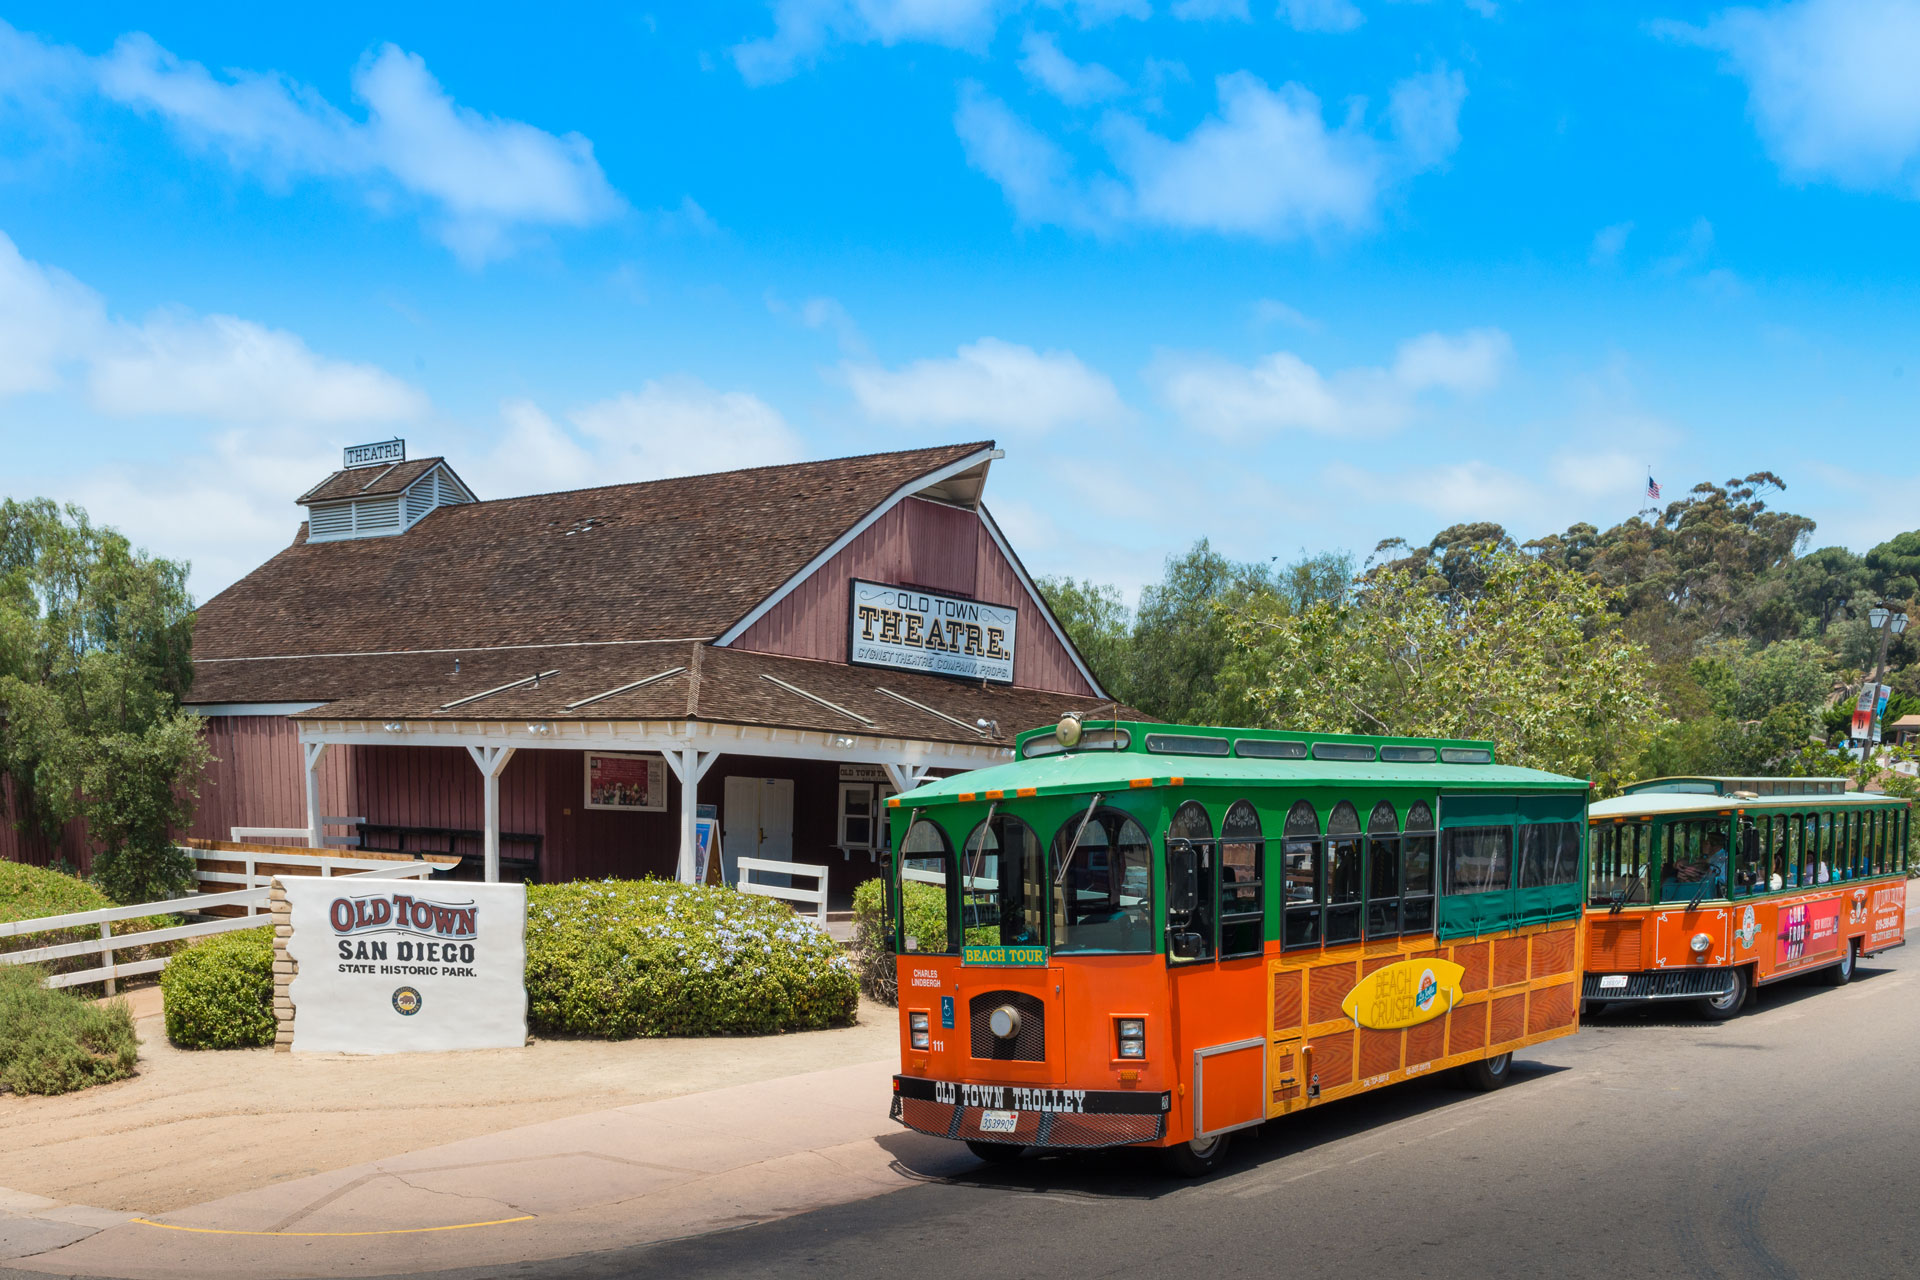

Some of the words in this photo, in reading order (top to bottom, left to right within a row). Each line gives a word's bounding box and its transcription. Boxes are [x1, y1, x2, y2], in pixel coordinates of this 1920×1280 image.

[348, 443, 402, 463] THEATRE.
[897, 593, 929, 613] OLD
[935, 599, 979, 621] TOWN
[858, 604, 1010, 661] THEATRE.
[857, 648, 894, 663] CYGNET
[896, 652, 934, 668] THEATRE
[936, 659, 977, 675] COMPANY,
[979, 665, 1009, 679] PROPS.
[856, 769, 876, 777] TOWN
[329, 897, 392, 933] OLD
[393, 894, 478, 936] TOWN
[338, 940, 387, 961] SAN
[397, 941, 475, 963] DIEGO
[965, 949, 1005, 962] BEACH
[1008, 949, 1044, 962] TOUR
[338, 964, 376, 974] STATE
[380, 965, 438, 975] HISTORIC
[442, 967, 477, 977] PARK.
[913, 969, 938, 978] CHARLES
[911, 978, 941, 988] LINDBERGH
[1375, 967, 1411, 1000] BEACH
[1371, 995, 1415, 1027] CRUISER
[933, 1040, 944, 1052] 111
[935, 1081, 956, 1104] OLD
[961, 1084, 1004, 1108] TOWN
[1012, 1088, 1086, 1113] TROLLEY
